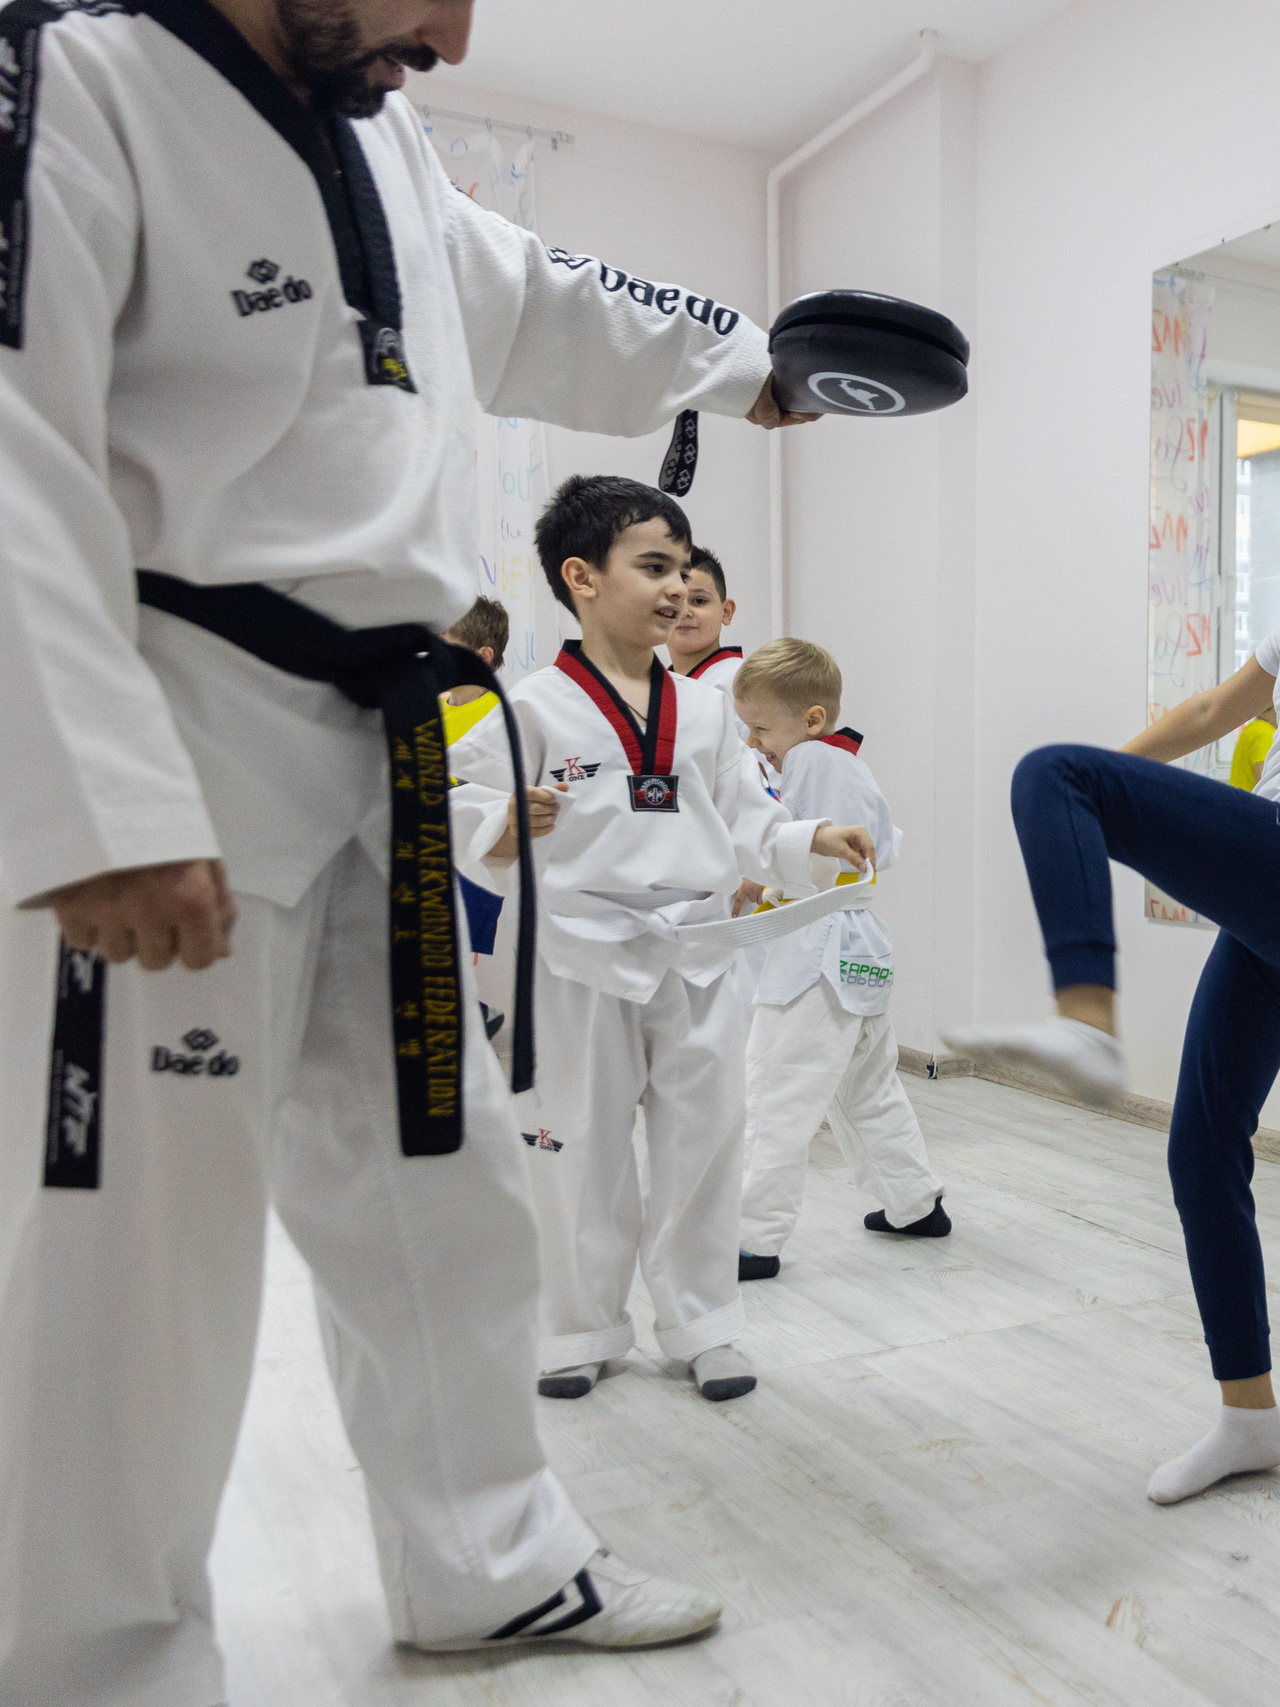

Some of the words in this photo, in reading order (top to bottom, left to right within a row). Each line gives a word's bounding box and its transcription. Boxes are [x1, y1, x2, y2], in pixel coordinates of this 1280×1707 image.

[413, 718, 444, 806] WORLD
[418, 823, 453, 968] TAEKWONDO
[423, 976, 458, 1118] FEDERATION
